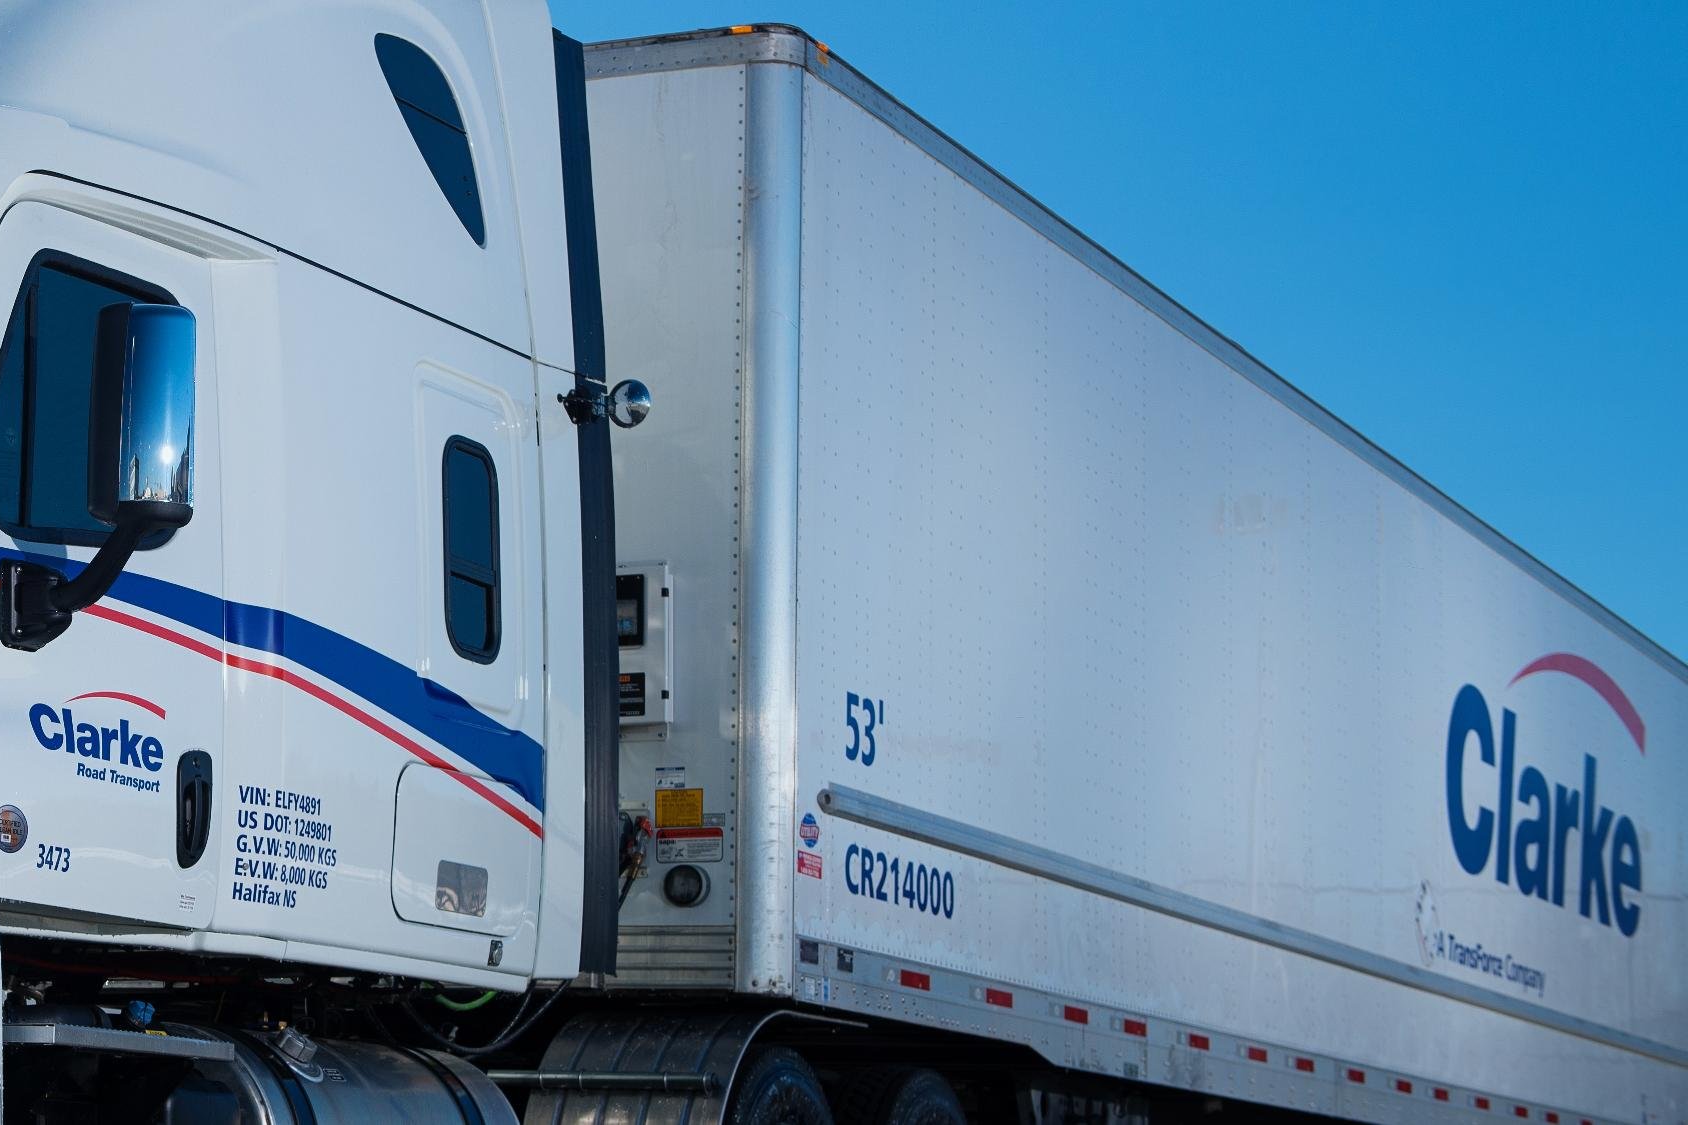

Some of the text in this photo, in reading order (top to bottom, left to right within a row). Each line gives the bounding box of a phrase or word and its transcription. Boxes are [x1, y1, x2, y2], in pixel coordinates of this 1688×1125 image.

[29, 703, 164, 772] Clarke
[845, 691, 884, 767] 53'
[77, 762, 161, 793] Road Transport
[239, 785, 321, 816] VIN: ELFY4891
[1446, 683, 1642, 938] Clarke
[237, 809, 332, 842] US DOT: 1249801
[36, 843, 71, 873] 3473
[236, 834, 337, 867] G.V.W: 50,000 KGS
[234, 857, 328, 889] E.V.W: 8,000 KGS
[845, 843, 955, 919] CR214000
[232, 881, 297, 908] Halifax NS
[1434, 930, 1445, 958] A
[1505, 954, 1546, 998] Company
